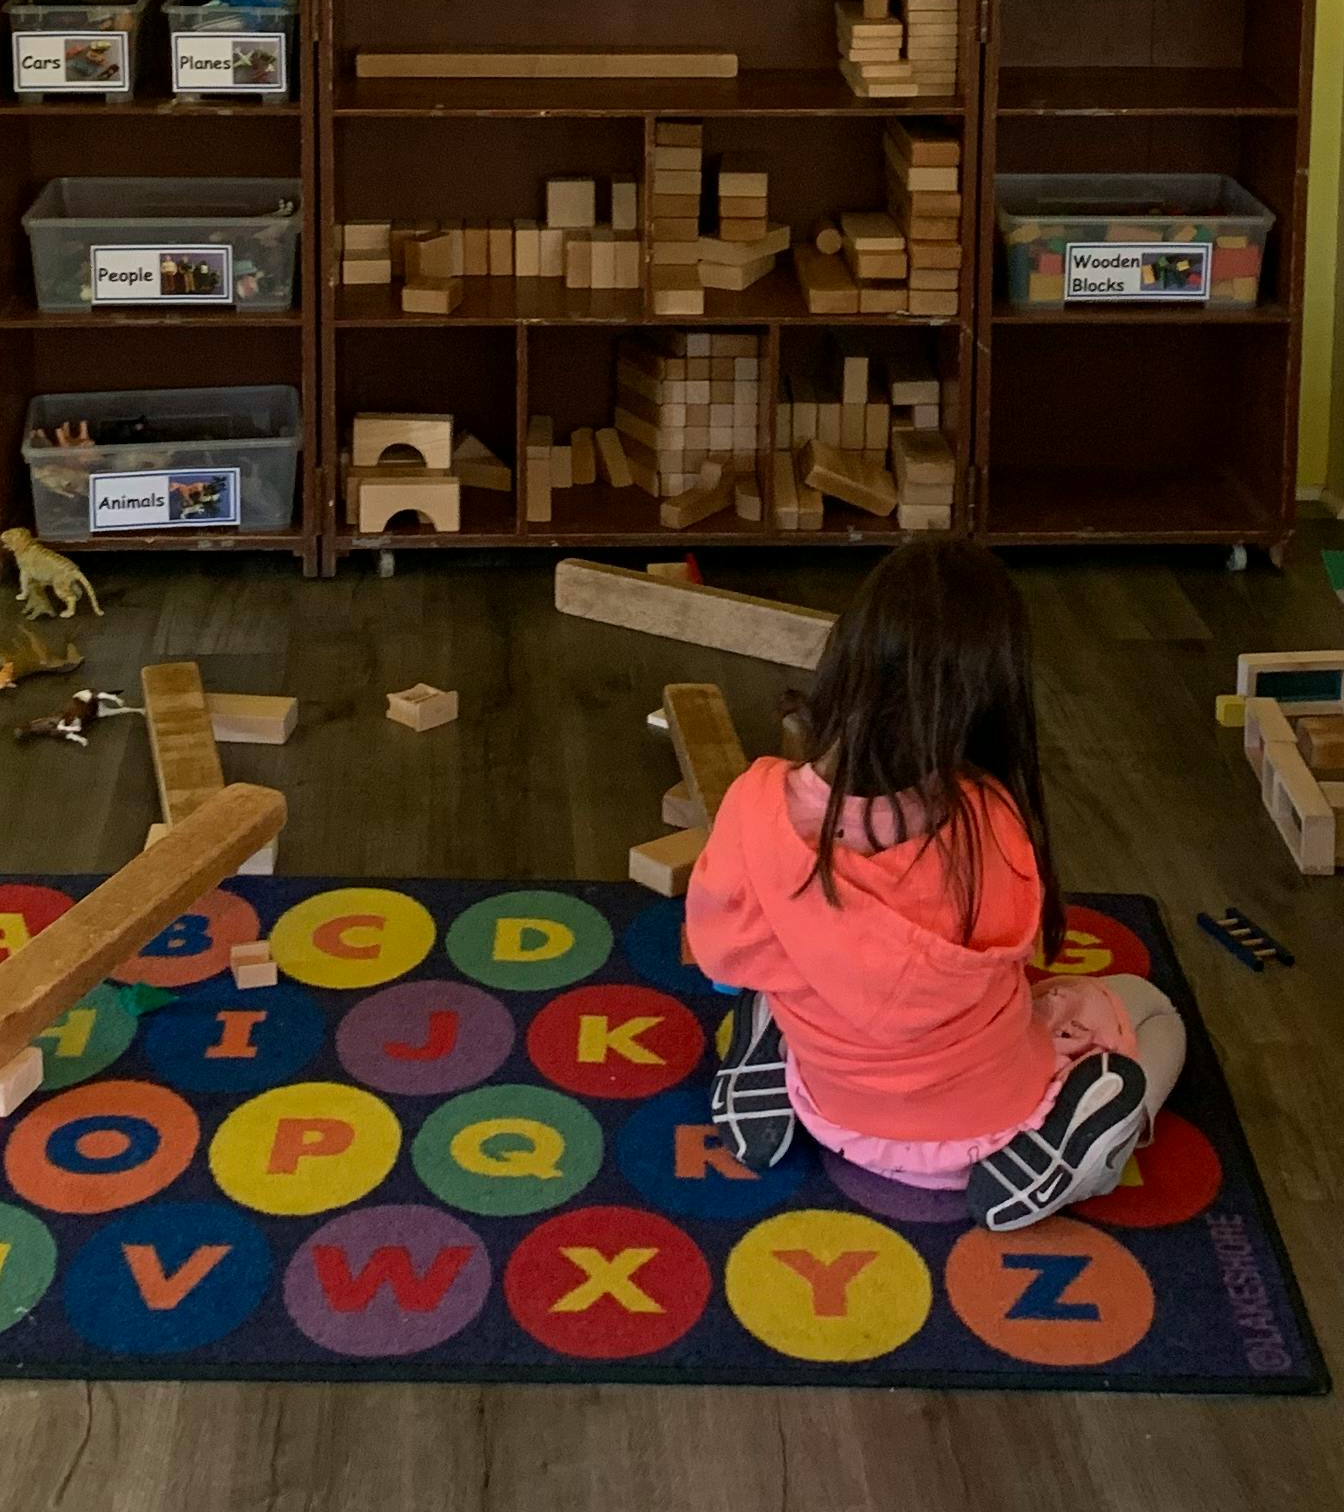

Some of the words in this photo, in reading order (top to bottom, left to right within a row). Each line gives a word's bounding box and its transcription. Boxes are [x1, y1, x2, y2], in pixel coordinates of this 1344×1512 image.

[21, 55, 61, 70] Cars
[179, 55, 232, 70] Planes
[1073, 254, 1141, 269] Wooden
[98, 266, 154, 287] People
[1071, 278, 1125, 293] Blocks
[98, 492, 166, 511] Animals
[137, 913, 214, 958] B
[310, 914, 390, 961] C
[492, 917, 575, 963] D
[204, 1009, 268, 1059] I
[381, 1011, 459, 1063] J
[576, 1015, 668, 1066] K
[45, 1114, 162, 1175] O
[265, 1118, 357, 1176] P
[451, 1118, 570, 1181] Q
[674, 1123, 762, 1179] R
[120, 1243, 235, 1311] V
[309, 1244, 479, 1314] W
[549, 1246, 668, 1315] X
[770, 1249, 882, 1319] Y
[1000, 1253, 1100, 1322] Z
